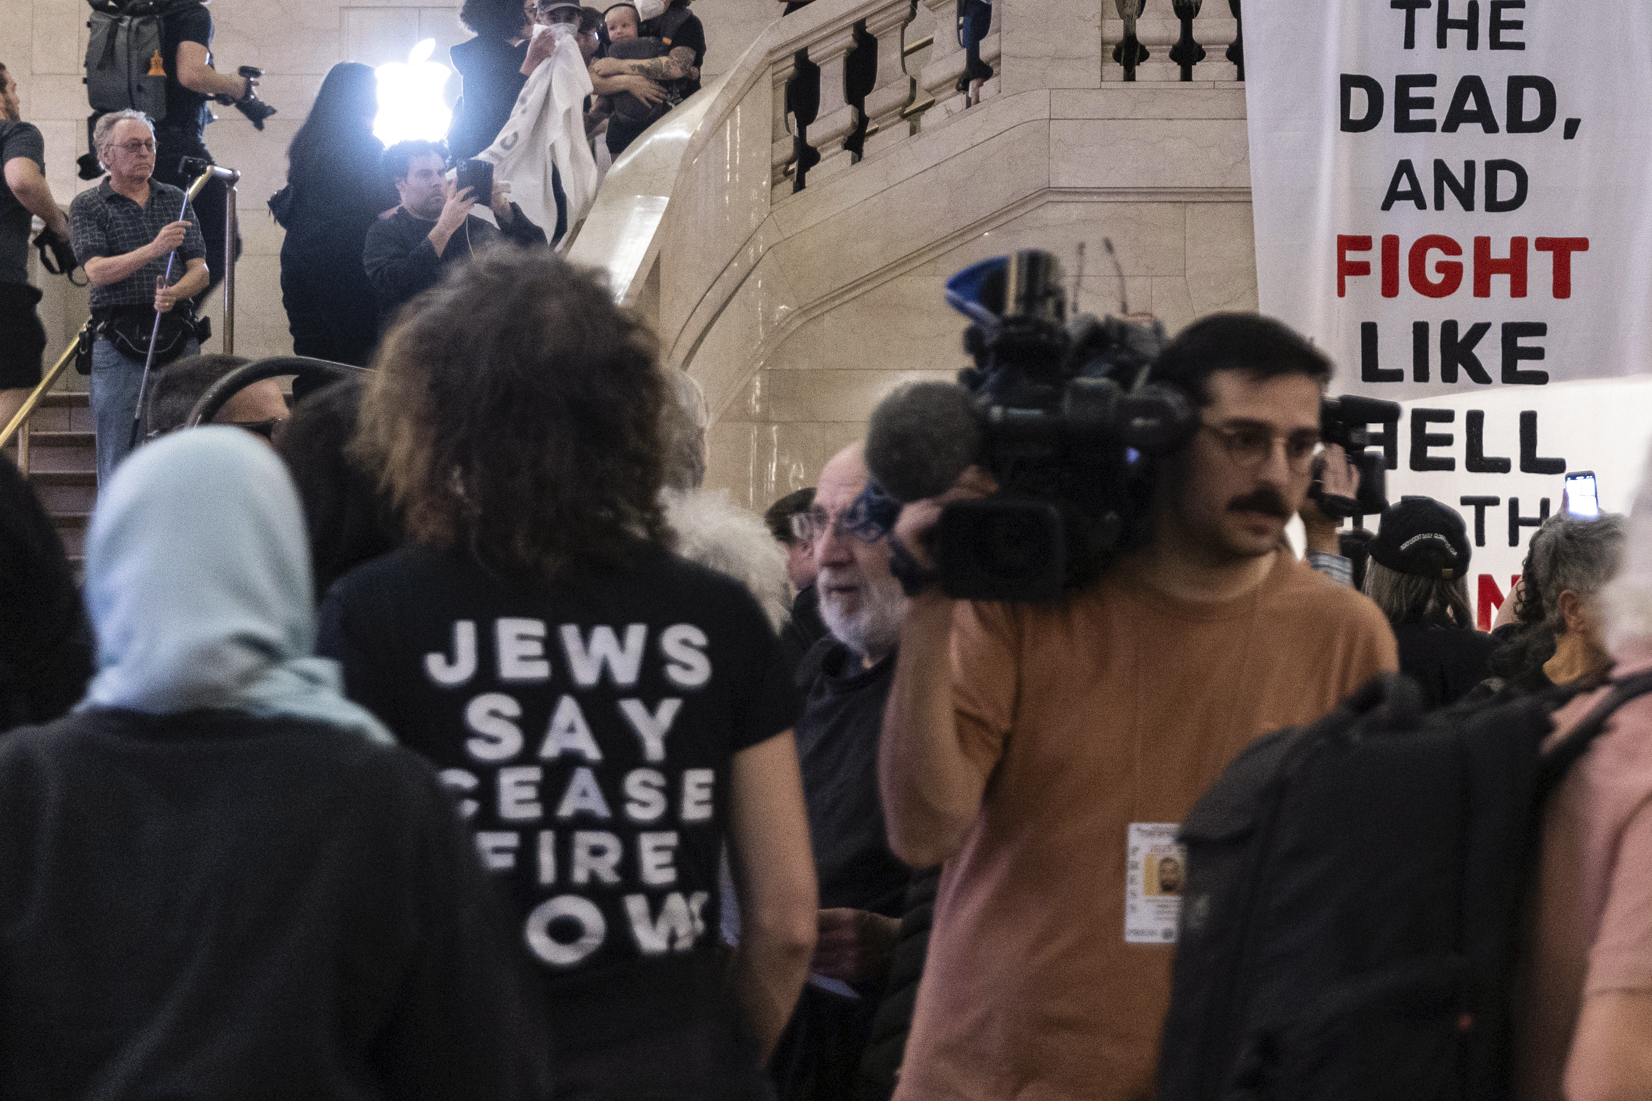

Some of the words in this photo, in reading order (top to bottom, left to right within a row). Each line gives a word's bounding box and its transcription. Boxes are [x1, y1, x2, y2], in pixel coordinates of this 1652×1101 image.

[1339, 72, 1582, 140] DEAD,
[1380, 157, 1529, 213] AND
[1336, 233, 1590, 300] FIGHT
[1360, 318, 1550, 386] LIKE
[1459, 494, 1550, 548] TH
[422, 615, 714, 688] JEWS
[463, 691, 686, 764] SAY
[474, 829, 680, 887] FIRE
[524, 891, 711, 966] OW
